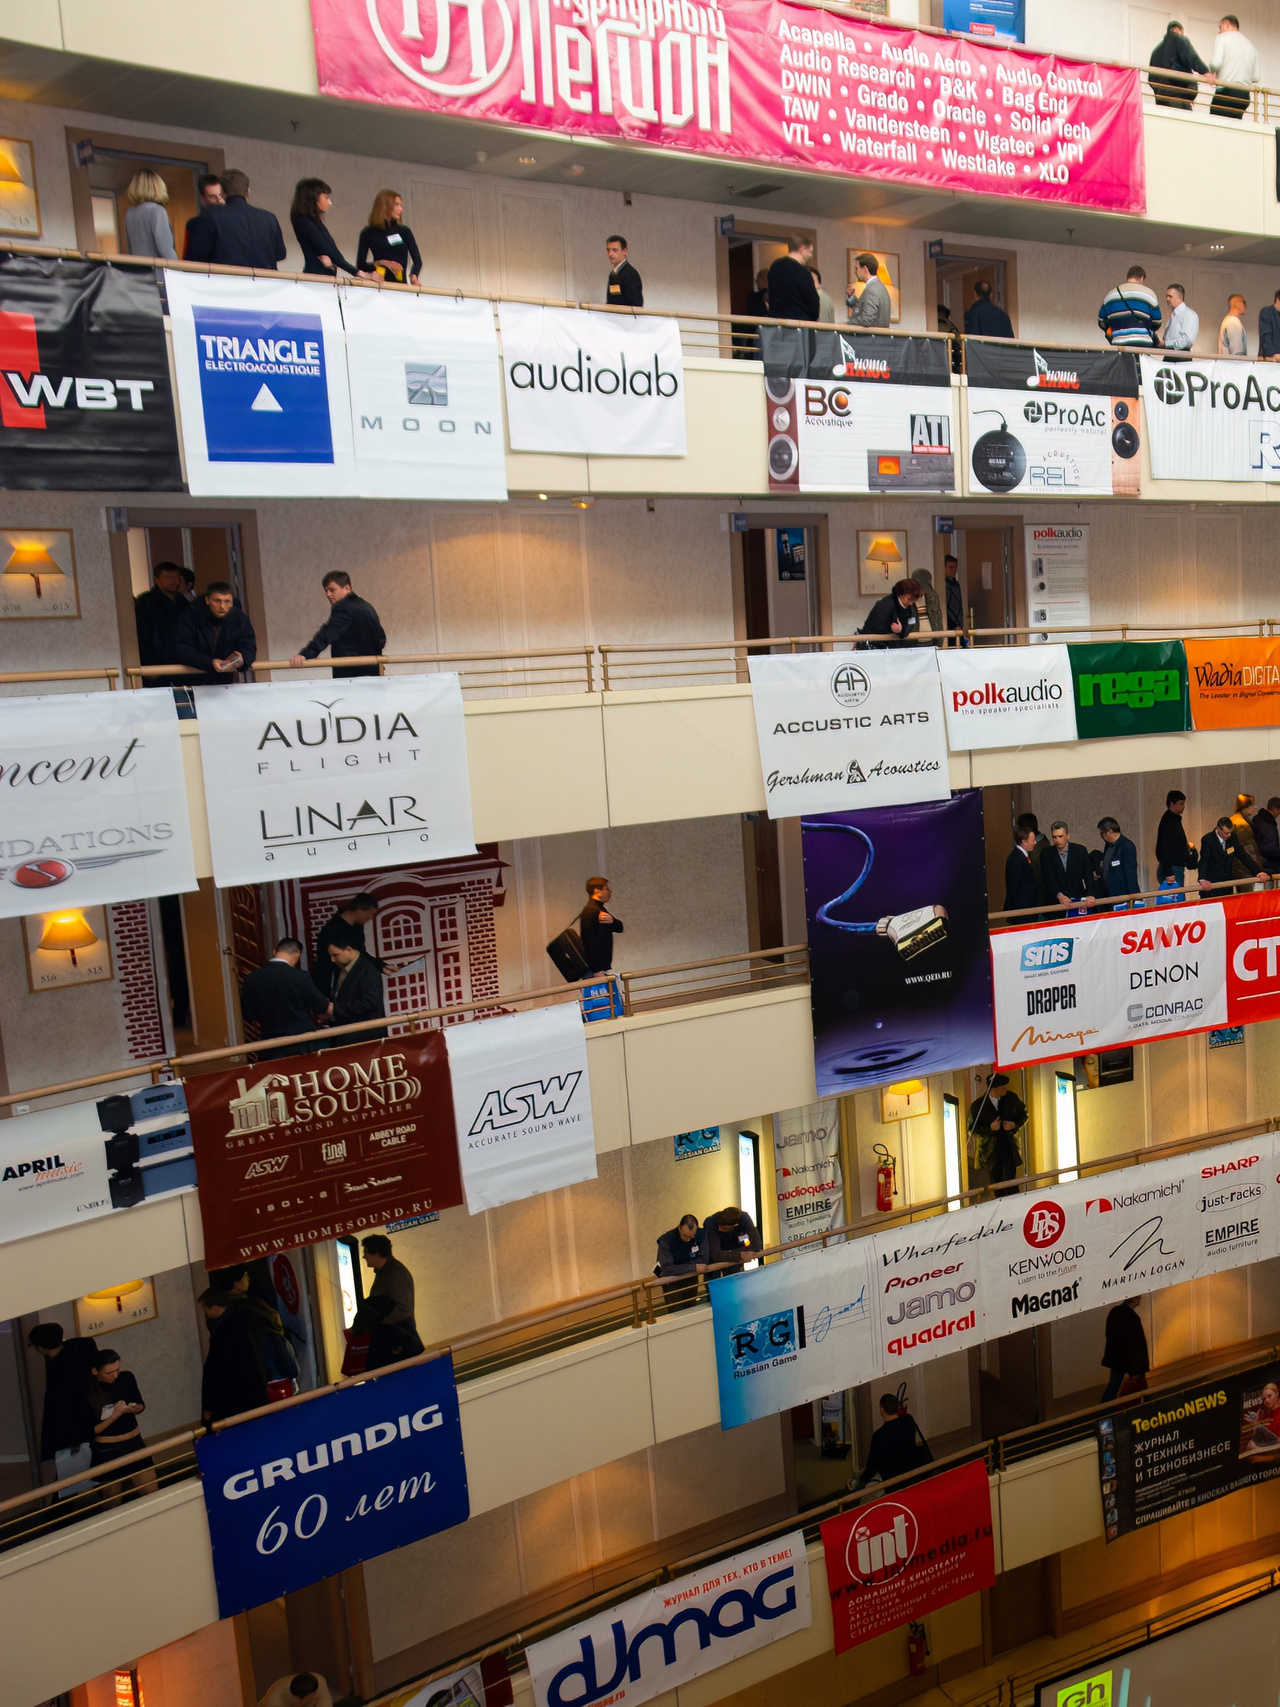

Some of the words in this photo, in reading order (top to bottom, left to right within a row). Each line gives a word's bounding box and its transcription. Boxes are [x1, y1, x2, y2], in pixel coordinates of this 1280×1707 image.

[779, 19, 855, 52] Acapella
[882, 42, 929, 69] Audio
[934, 53, 971, 76] Aero
[997, 63, 1043, 88] Audio
[1048, 76, 1103, 98] Control
[780, 48, 832, 73] Audio
[838, 58, 914, 89] Research
[940, 76, 977, 99] B&K
[1002, 86, 1034, 113] Bag
[1039, 93, 1068, 115] End
[781, 70, 831, 98] DWIN
[858, 85, 908, 113] Grado
[933, 101, 985, 126] Oracle
[1010, 111, 1052, 136] Solid
[1056, 118, 1091, 140] Tech
[782, 95, 819, 121] TAW
[846, 107, 950, 143] Vandersteen
[974, 129, 1035, 156] Vigatec
[1057, 142, 1083, 163] VPI
[782, 122, 814, 147] VTL
[840, 131, 917, 162] Waterfall
[942, 148, 1015, 177] Westlake
[1039, 161, 1069, 184] XLO
[200, 334, 321, 365] TRIANGLE
[205, 359, 321, 377] ELECTROACOUSTIQUE
[510, 348, 679, 398] audiolab
[6, 372, 155, 411] WBT
[361, 415, 492, 435] MOON
[1044, 401, 1106, 426] ProAc
[1030, 465, 1079, 486] REL
[1033, 527, 1082, 540] polkaudio
[952, 679, 1063, 713] polkaudio
[1078, 669, 1181, 708] rega
[257, 712, 419, 751] AUDIA
[773, 716, 872, 735] ACCUSTIC
[880, 711, 930, 727] ARTS
[257, 749, 421, 775] FLIGHT
[766, 768, 844, 793] Gershman
[867, 759, 941, 779] Acoustics
[260, 795, 427, 841] LINAR
[264, 833, 430, 862] audio
[1120, 920, 1206, 955] SANYO
[905, 970, 952, 986] WWW.QED.RU
[1130, 962, 1199, 990] DENON
[1145, 998, 1203, 1020] CONRAC
[291, 1054, 408, 1100] HOME
[294, 1079, 412, 1123] SOUND
[468, 1070, 583, 1136] ASW
[226, 1132, 275, 1150] GREAT
[285, 1120, 334, 1137] SOUND
[342, 1103, 413, 1123] SUPPLIER
[369, 1128, 395, 1142] ABBEY
[396, 1124, 416, 1134] ROAD
[381, 1135, 406, 1147] CABLE
[468, 1131, 517, 1150] ACCURATE
[522, 1122, 554, 1136] SOUND
[558, 1114, 581, 1126] WAVE
[2, 1154, 66, 1183] APRIL
[245, 1155, 289, 1180] ASW
[1201, 1155, 1259, 1179] SHARP
[778, 1180, 836, 1201] audioquest
[1113, 1181, 1182, 1209] Nakamichi
[1201, 1185, 1262, 1213] just-racks
[786, 1198, 832, 1219] EMPIRE
[240, 1200, 433, 1258] WWW.HOMESOUND.RU
[882, 1220, 1014, 1267] Wharfedale
[1205, 1218, 1259, 1244] EMPIRE
[1008, 1244, 1085, 1277] KENWOOD
[1207, 1246, 1227, 1257] audio
[1229, 1238, 1259, 1252] furniture
[884, 1262, 964, 1294] Pioneer
[1018, 1273, 1037, 1285] Listen
[1046, 1268, 1057, 1278] the
[1057, 1264, 1077, 1275] Future
[1102, 1270, 1148, 1290] MARTIN
[1150, 1259, 1186, 1276] LOGAN
[1012, 1279, 1079, 1319] Magnat
[887, 1310, 976, 1356] quadral
[733, 1361, 770, 1380] Russian
[772, 1353, 797, 1367] Game
[1131, 1390, 1228, 1434] TechnoNEWS
[223, 1404, 444, 1500] GRUNDIG
[1134, 1430, 1180, 1454] ЖУРНАЛ
[1135, 1457, 1143, 1467] О
[1146, 1439, 1195, 1464] ТЕХНИКЕ
[1146, 1440, 1231, 1479] ТЕХНОБИЗНЕСЕ
[1191, 1496, 1197, 1504] В
[1230, 1473, 1258, 1491] ВАШЕГО
[256, 1493, 328, 1555] 60
[345, 1472, 436, 1522] лет
[663, 1587, 701, 1609] ЖУРНАЛ
[702, 1577, 721, 1594] ДЛЯ
[722, 1571, 742, 1584] ТЕХ,
[743, 1563, 759, 1576] КТО
[761, 1559, 767, 1569] В
[768, 1549, 792, 1565] ТЕМЕ!
[848, 1578, 906, 1607] ДОМАШНИЕ
[909, 1552, 966, 1581] КИНОТЕАТРЫ
